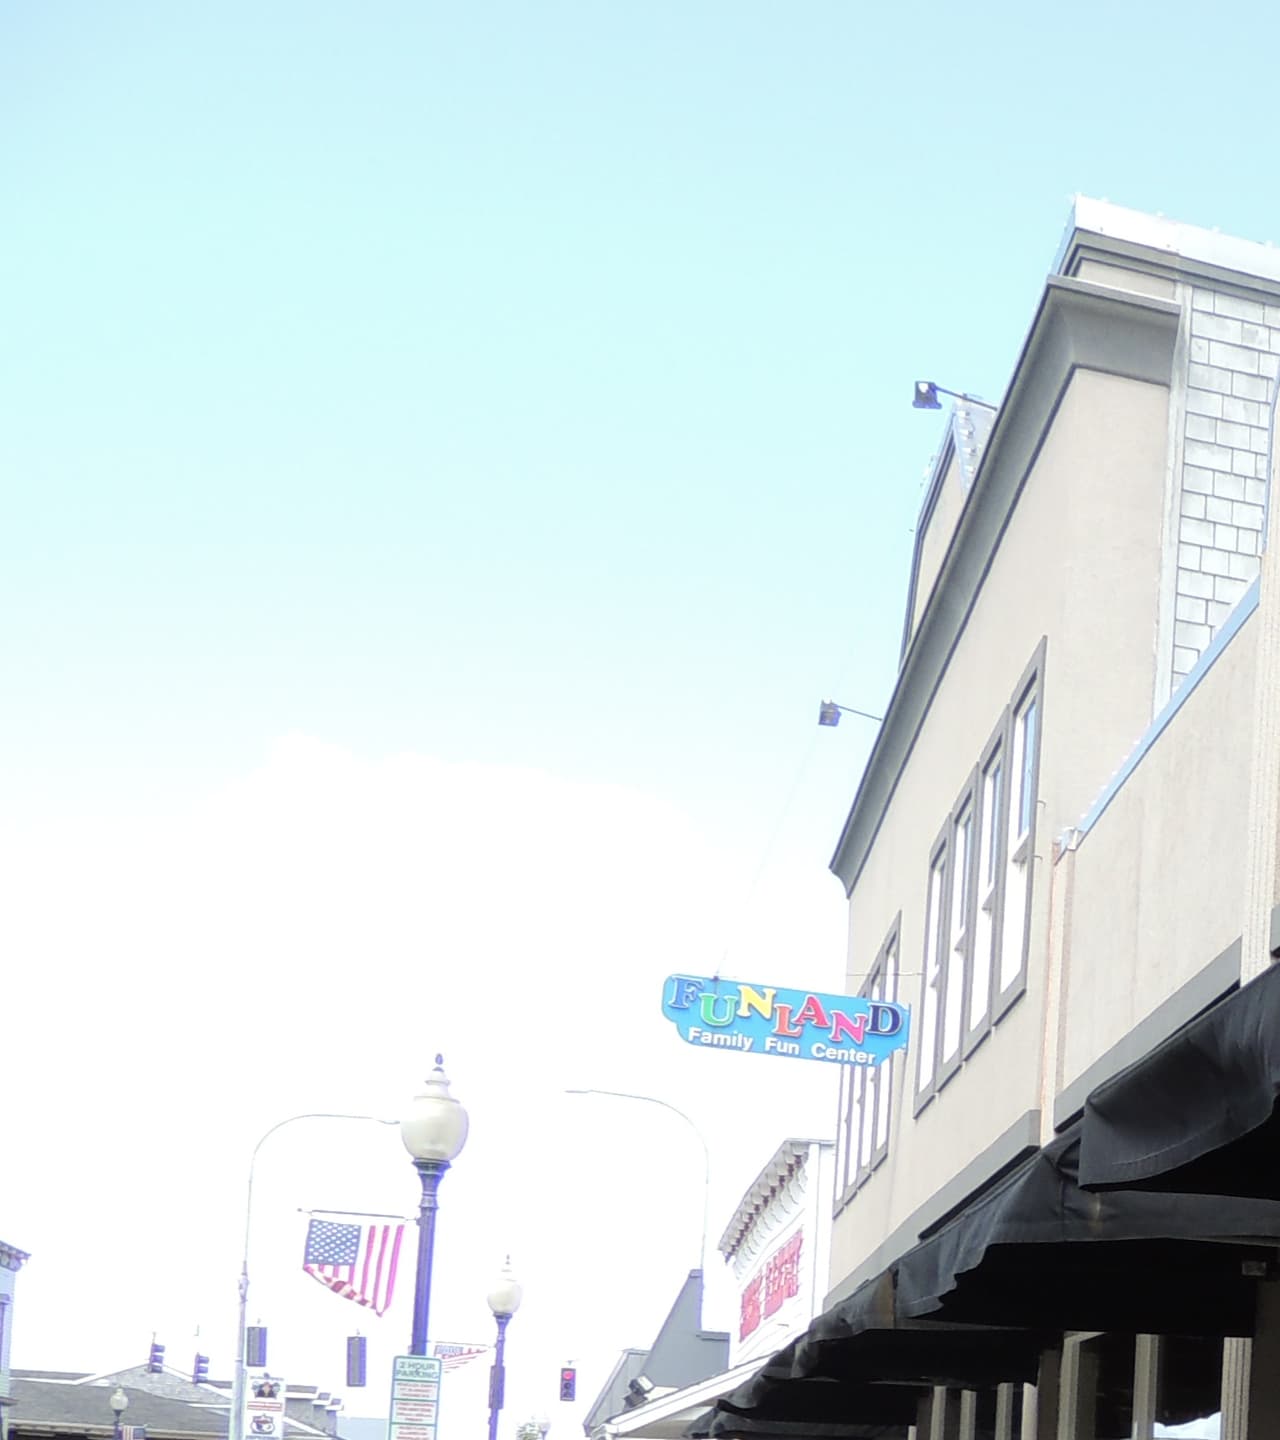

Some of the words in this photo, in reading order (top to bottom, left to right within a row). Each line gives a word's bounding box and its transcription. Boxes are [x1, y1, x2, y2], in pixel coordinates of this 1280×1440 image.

[668, 976, 902, 1045] FUNLAND
[688, 1026, 754, 1051] Family
[765, 1037, 800, 1055] Fun
[811, 1042, 877, 1065] Center
